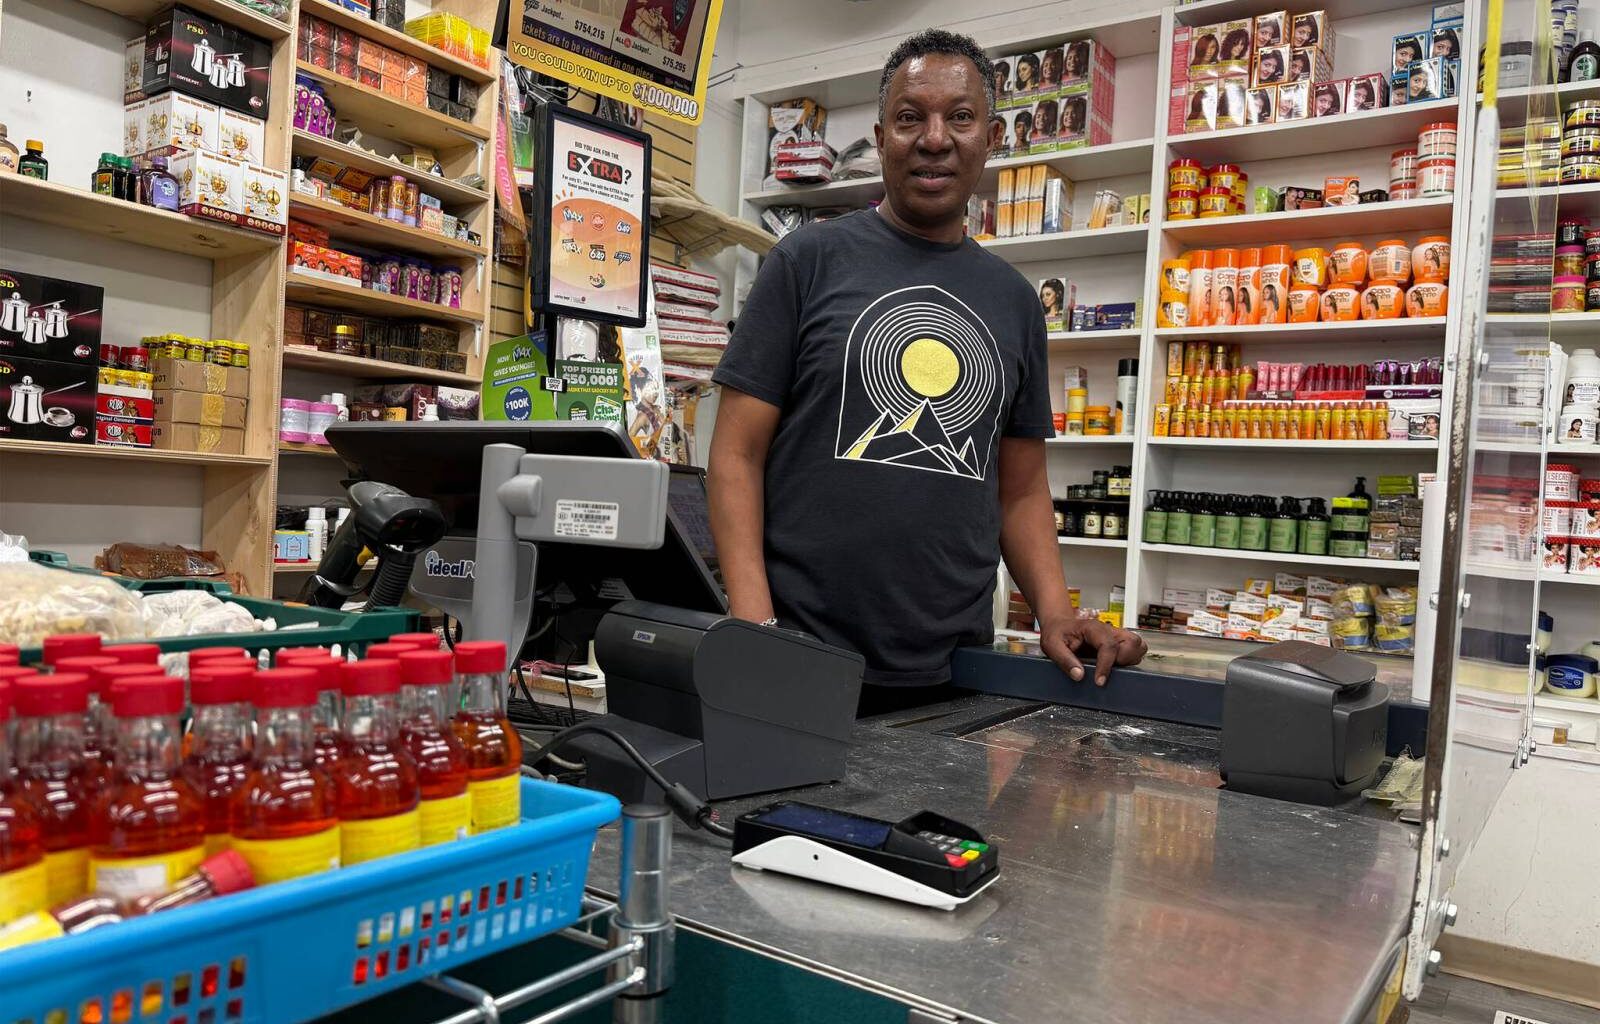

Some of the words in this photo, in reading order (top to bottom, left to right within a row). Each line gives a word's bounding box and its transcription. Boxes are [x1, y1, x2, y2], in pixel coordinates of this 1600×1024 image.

[186, 24, 204, 35] PSD
[574, 19, 605, 40] $754,215
[547, 33, 560, 45] are
[562, 36, 571, 48] to
[571, 39, 580, 53] be
[581, 44, 613, 65] returned
[662, 56, 687, 73] $75,295
[512, 41, 537, 60] YOU
[538, 51, 575, 74] COULD
[576, 65, 600, 82] WIN
[600, 73, 615, 87] UP
[616, 79, 631, 93] TO
[632, 81, 699, 121] $1,000,000
[583, 144, 592, 152] YOU
[568, 153, 622, 183] EXTRA
[562, 365, 579, 373] TOP
[563, 374, 618, 386] $50,000!
[505, 398, 530, 411] $100K
[427, 557, 475, 578] idealP
